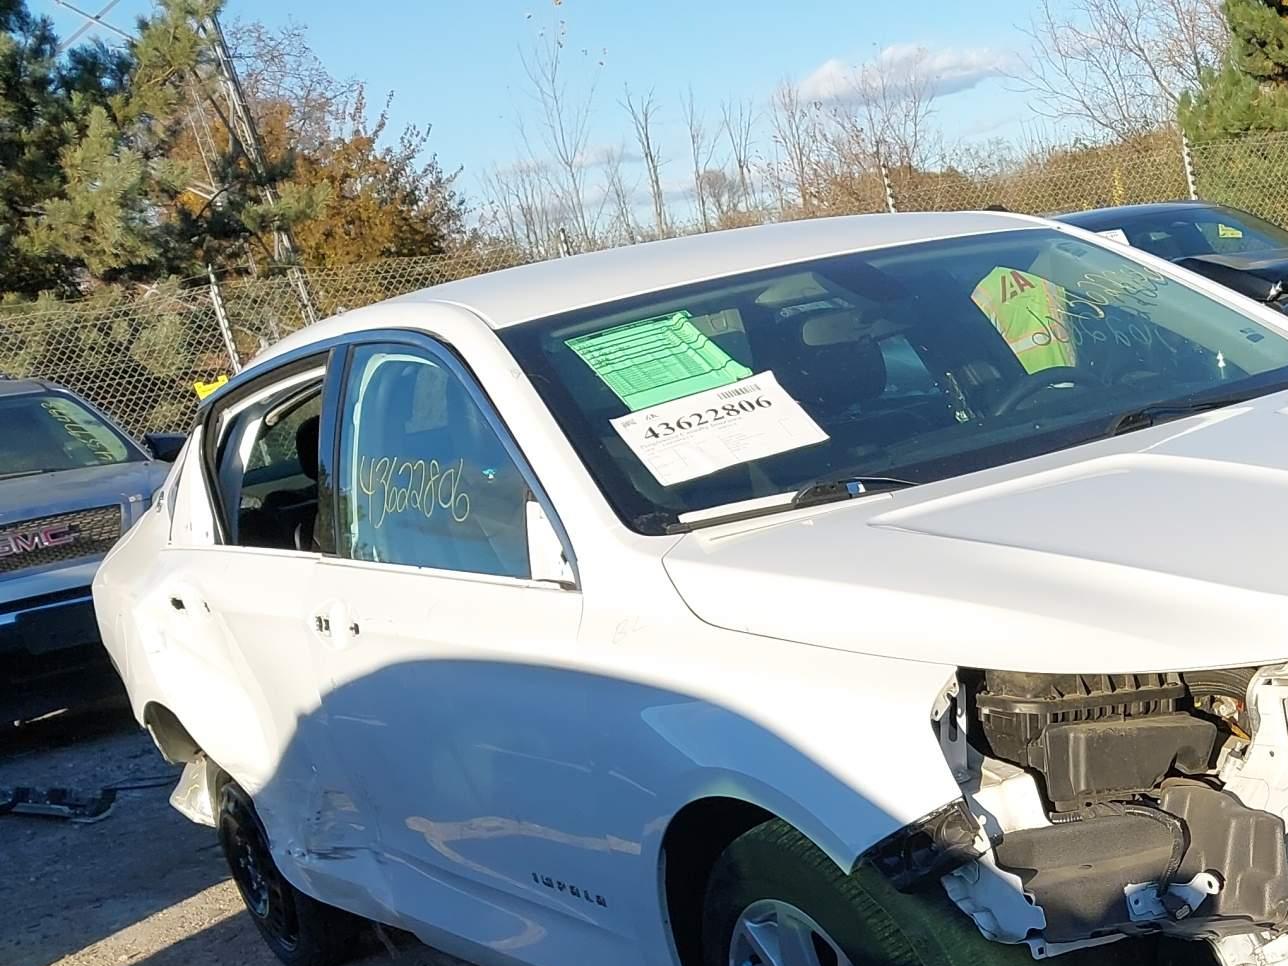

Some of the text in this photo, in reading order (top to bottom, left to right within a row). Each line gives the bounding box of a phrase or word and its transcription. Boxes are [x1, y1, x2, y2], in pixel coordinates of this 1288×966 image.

[643, 395, 773, 441] 43622806
[359, 455, 470, 529] 43622806
[531, 872, 608, 908] IMPALA
